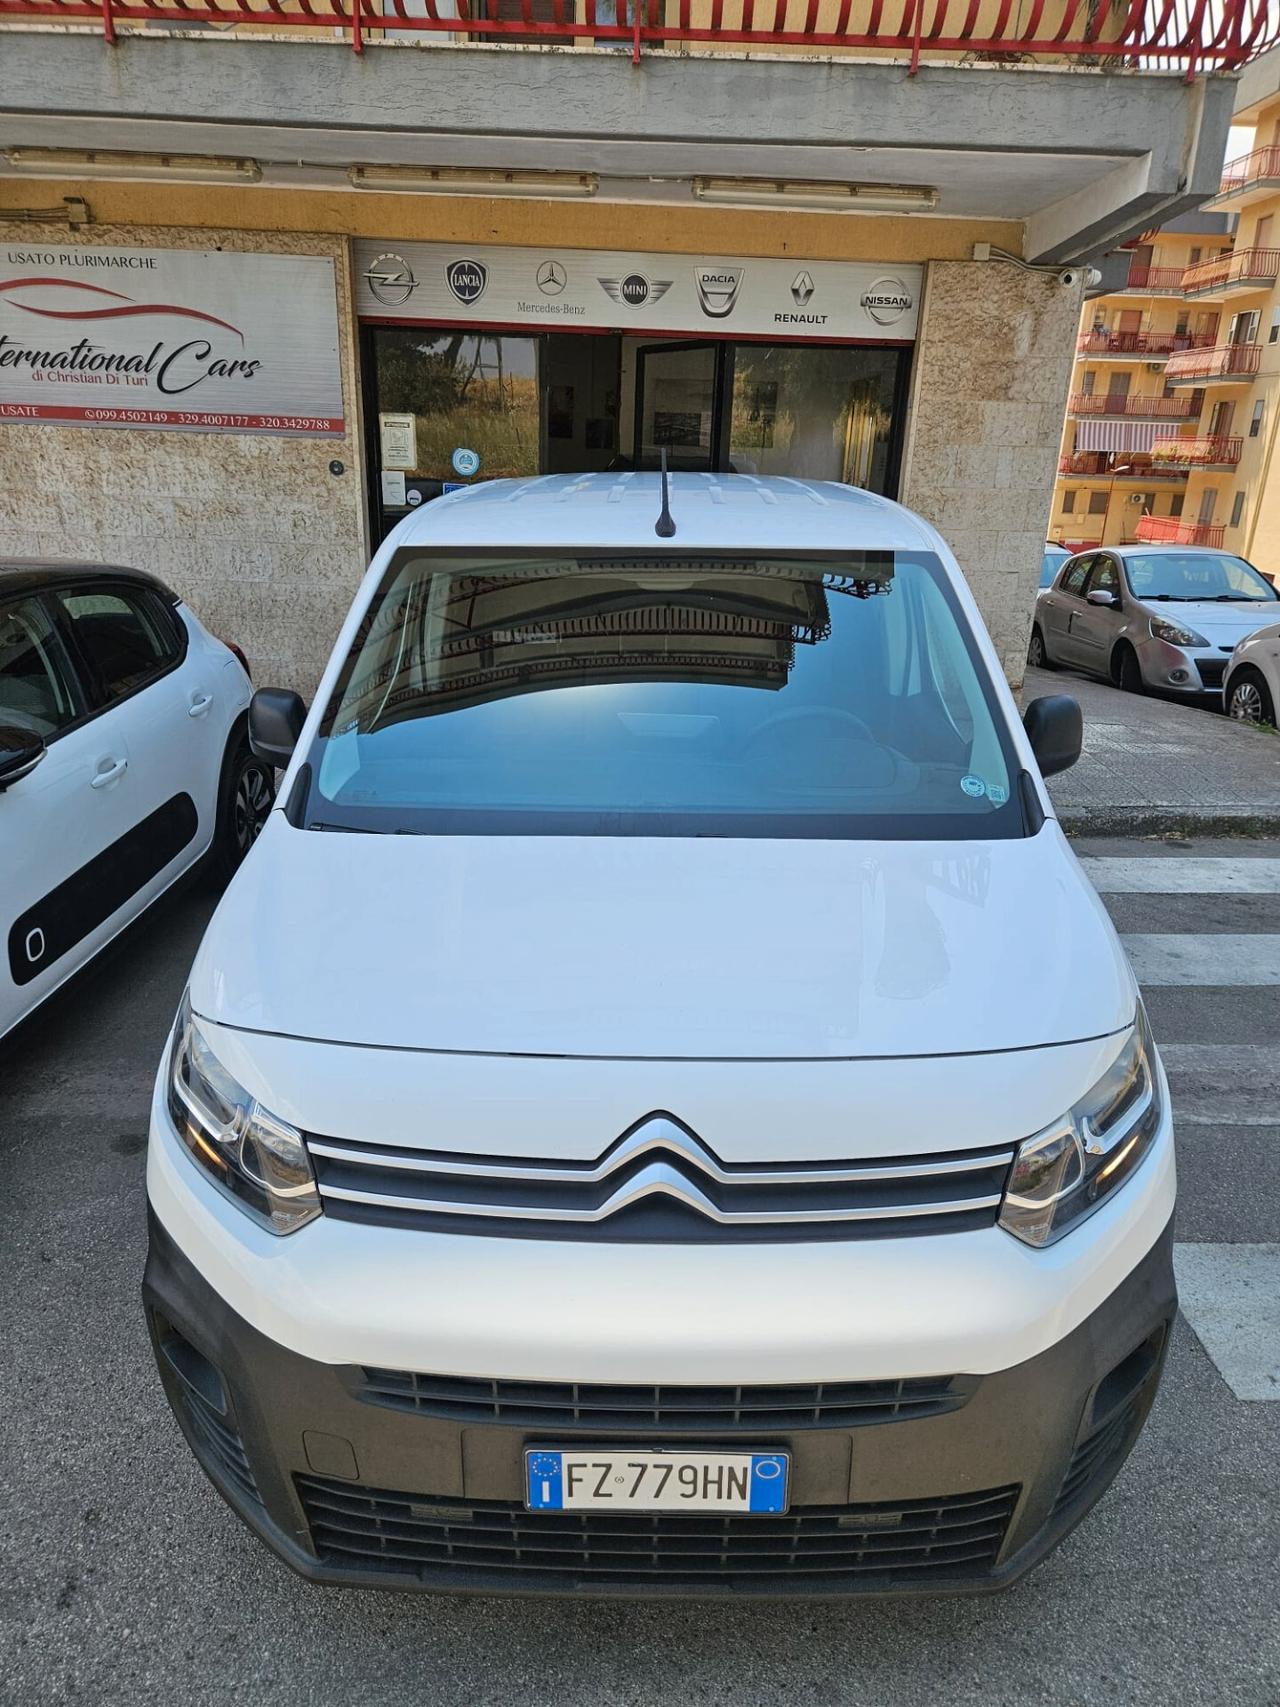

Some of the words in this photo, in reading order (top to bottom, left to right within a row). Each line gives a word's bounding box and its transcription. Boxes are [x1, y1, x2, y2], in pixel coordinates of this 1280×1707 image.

[8, 252, 55, 265] USATO
[60, 254, 157, 269] PLURIMARCHE
[454, 274, 480, 287] LANCIA
[702, 274, 735, 284] DACIA
[623, 284, 647, 295] MINI
[865, 295, 908, 306] NISSAN
[517, 302, 585, 315] Mercedes-Benz
[774, 313, 828, 324] RENAULT
[156, 340, 263, 394] Cars
[32, 370, 43, 381] di
[47, 371, 102, 384] Christian
[106, 374, 120, 384] Di
[125, 375, 148, 386] Turi
[1, 405, 39, 416] USATE
[178, 413, 249, 426] 329.4007177
[260, 417, 330, 429] 320.3429788
